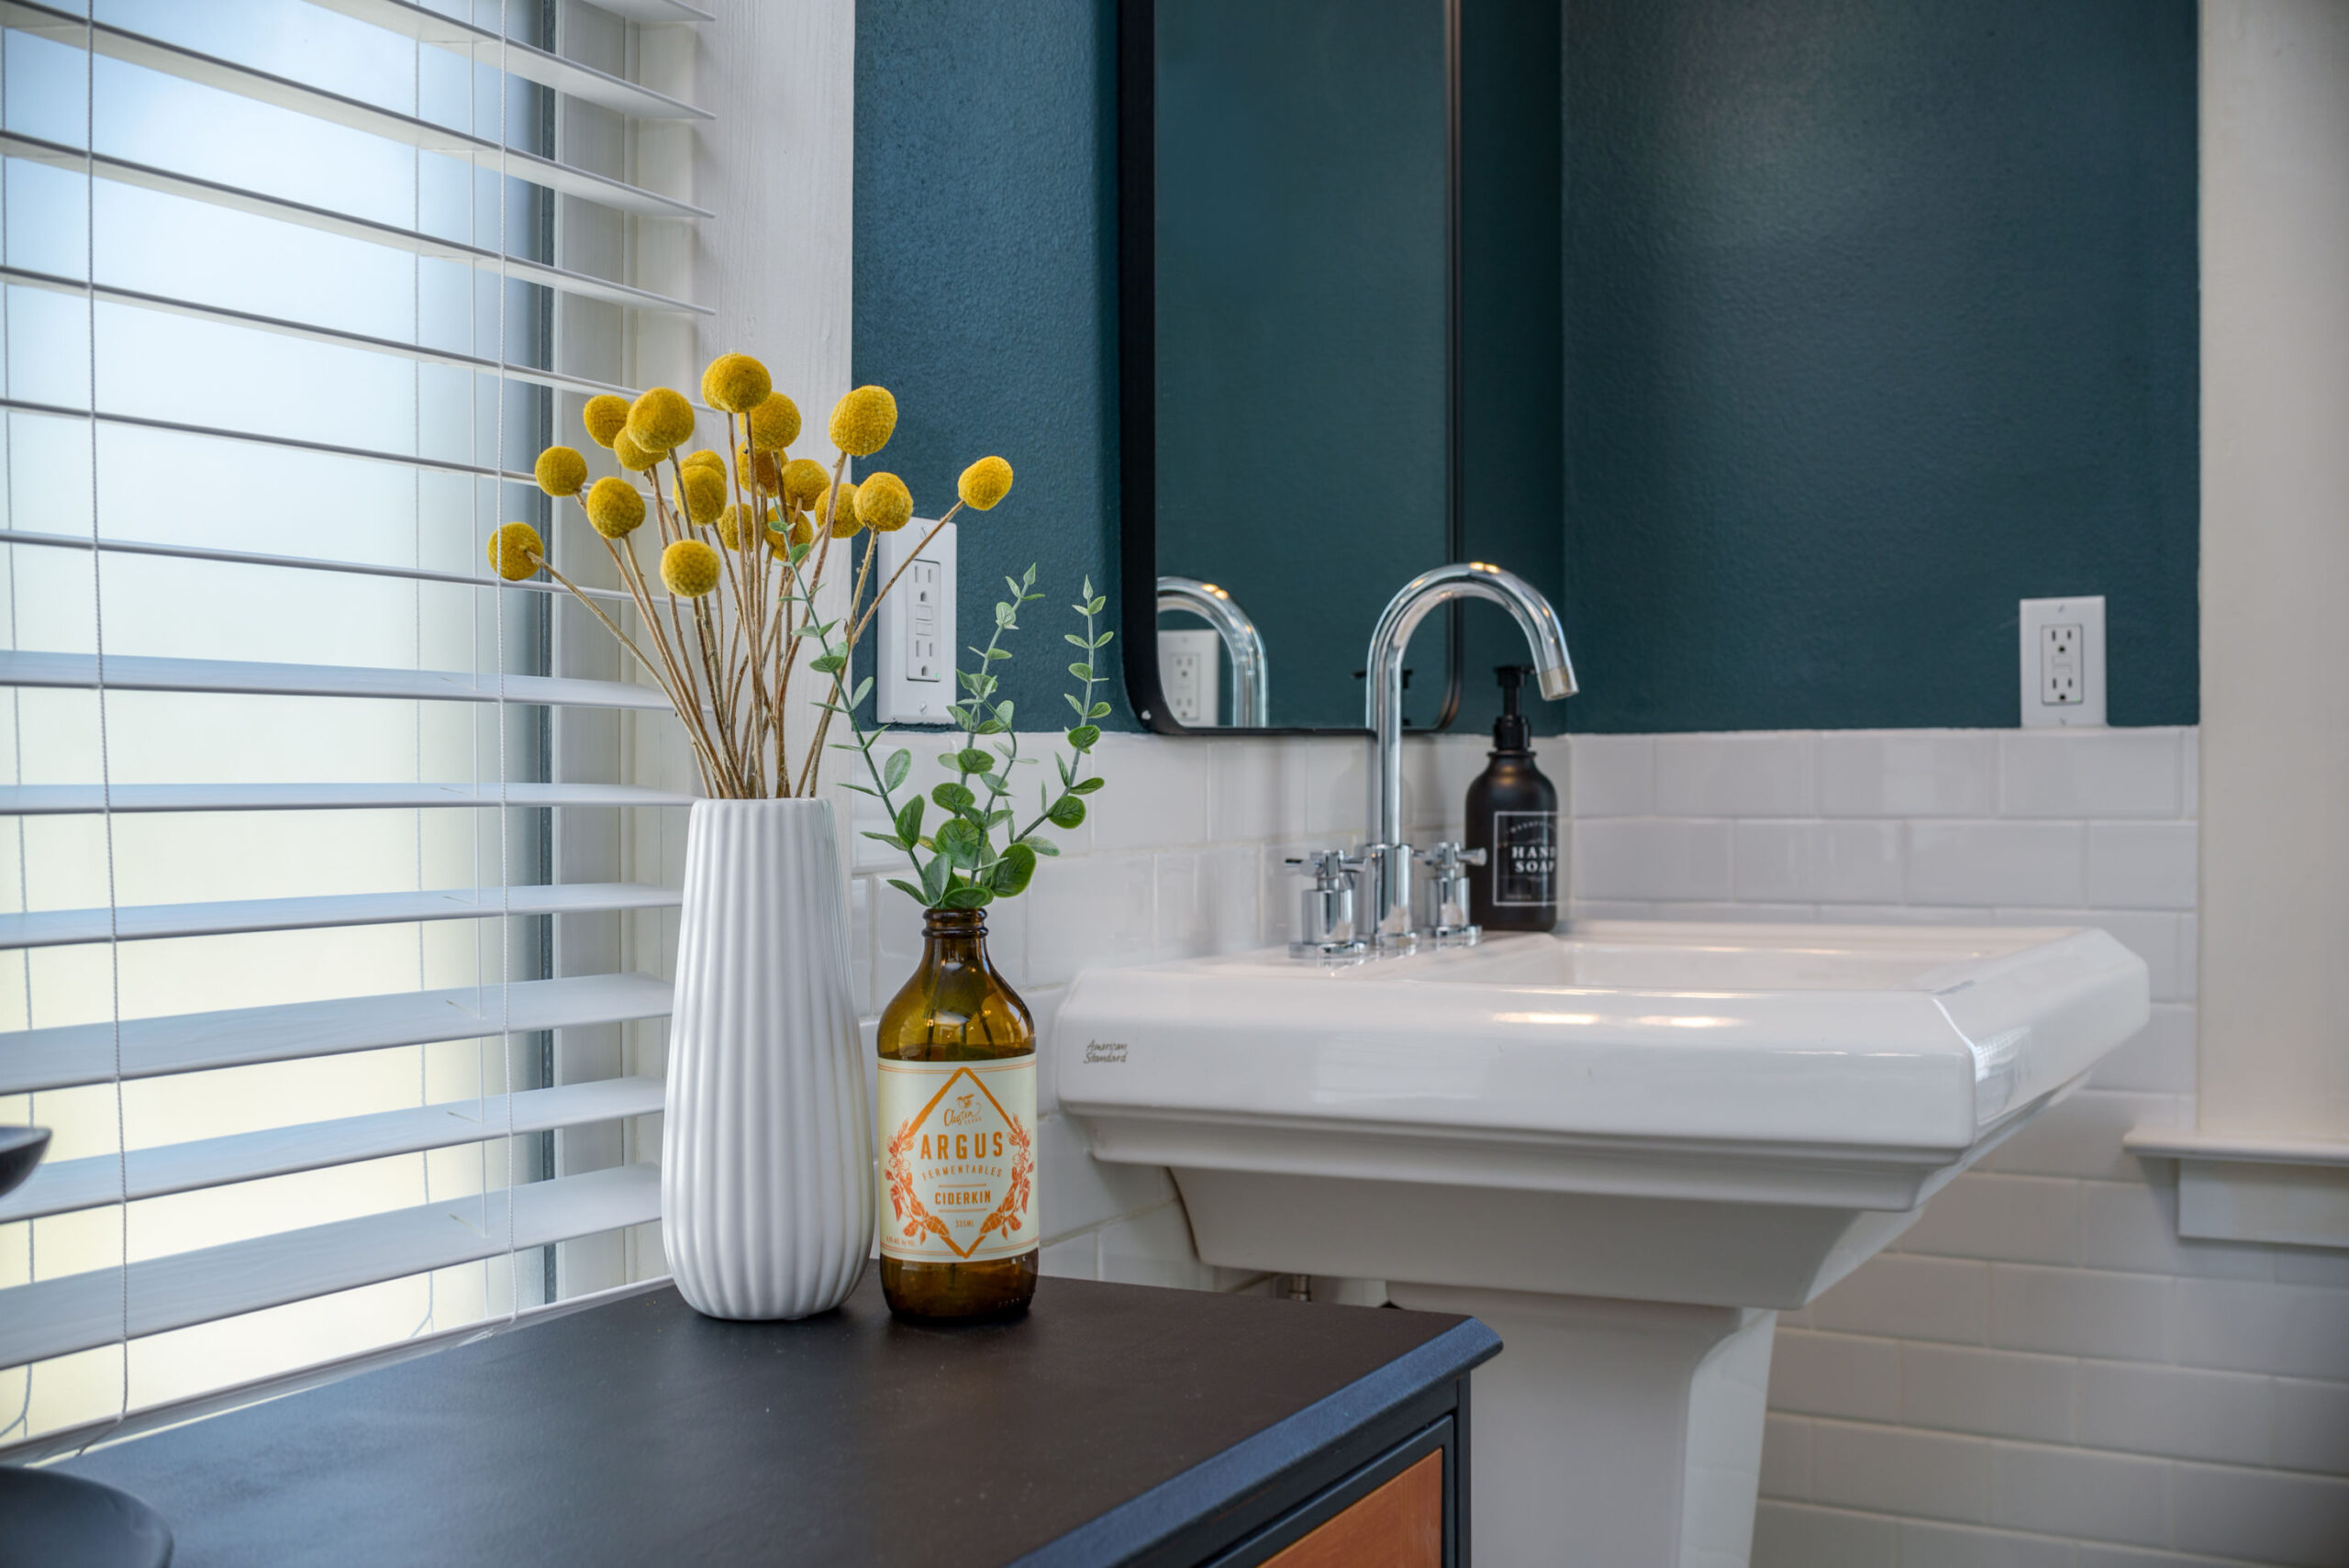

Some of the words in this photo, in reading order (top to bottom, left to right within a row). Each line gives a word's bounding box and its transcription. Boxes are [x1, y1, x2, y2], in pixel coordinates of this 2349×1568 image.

[1083, 1051, 1129, 1063] Standard
[943, 1105, 980, 1127] Austin
[920, 1131, 1003, 1160] ARGUS
[921, 1164, 1002, 1181] FERMENTABLES
[934, 1190, 991, 1205] CIDERKIN
